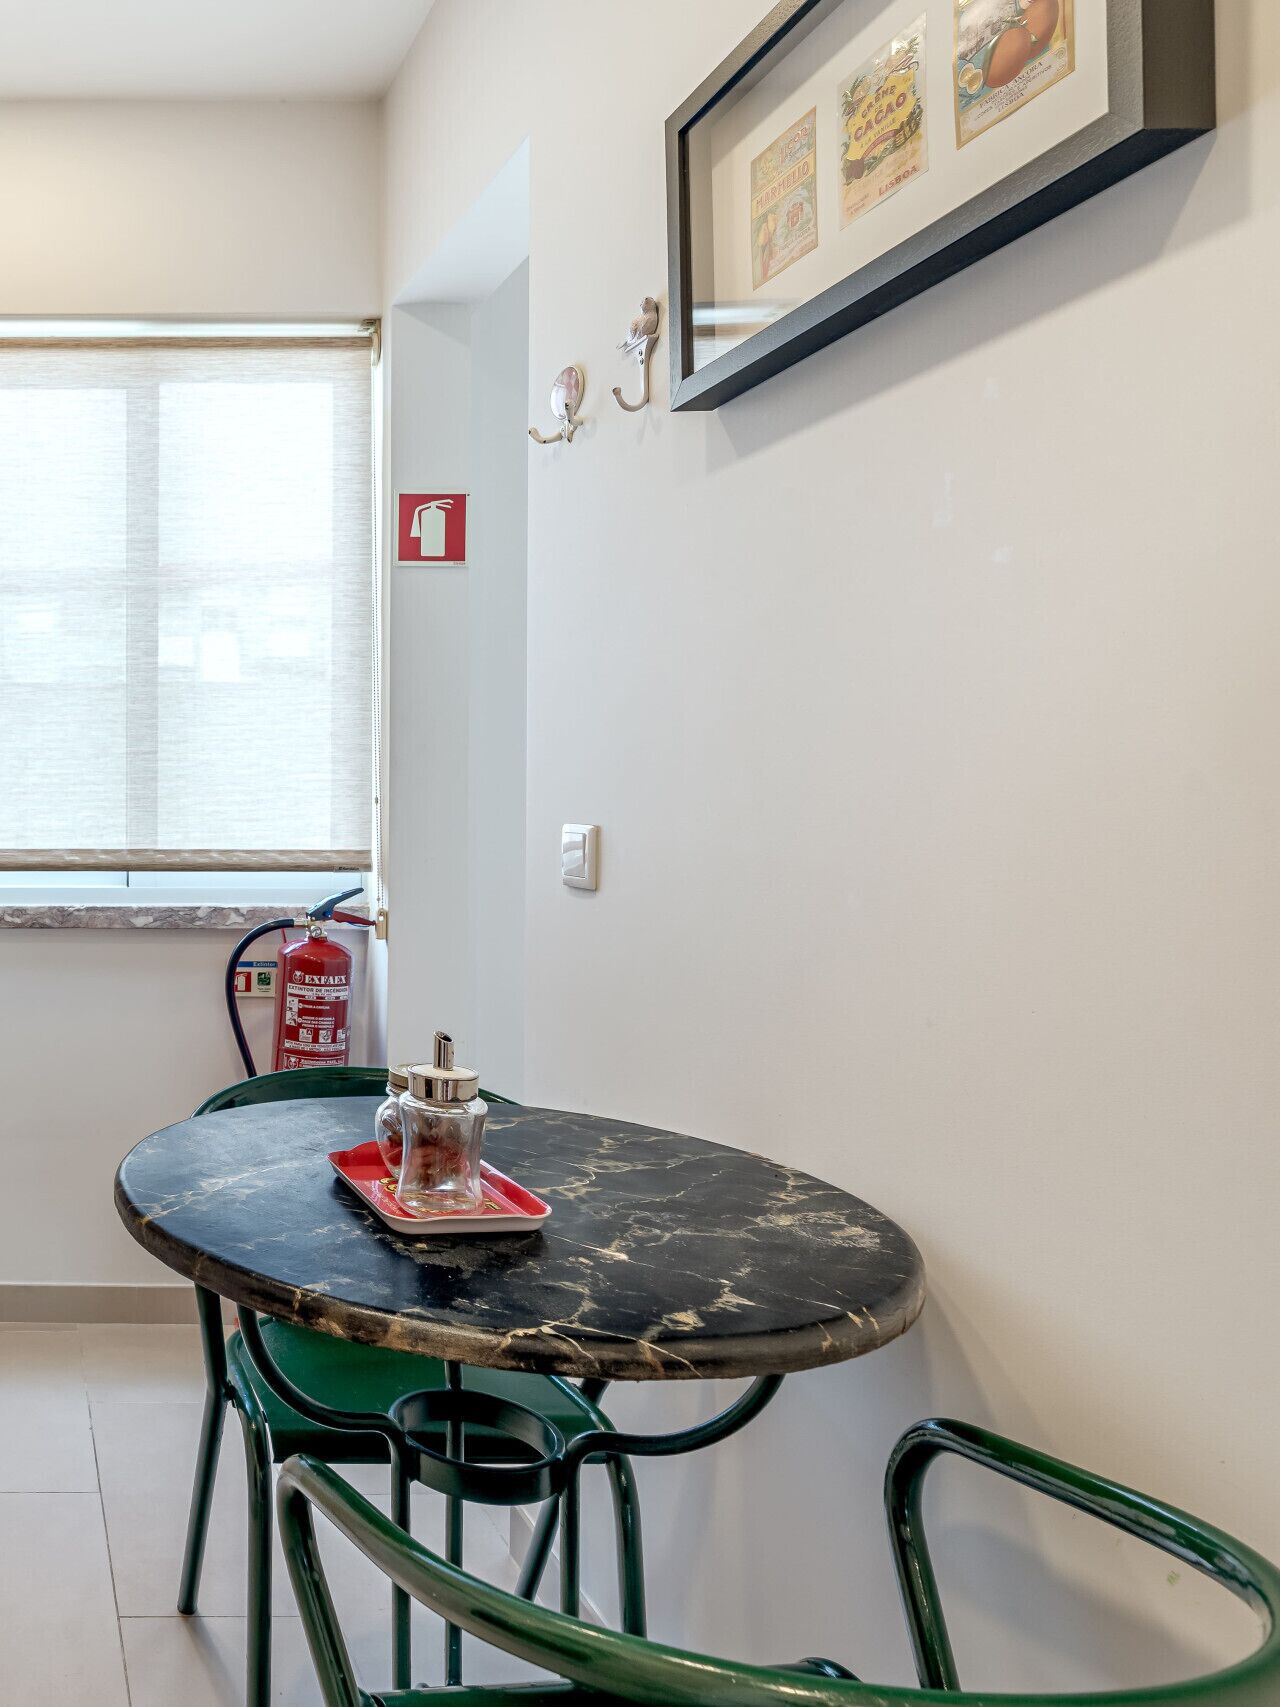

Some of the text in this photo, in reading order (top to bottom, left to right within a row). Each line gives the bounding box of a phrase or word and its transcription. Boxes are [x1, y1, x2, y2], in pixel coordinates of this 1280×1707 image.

[853, 92, 907, 142] CACAO
[878, 164, 920, 197] LISBOA
[288, 984, 314, 992] EXTINTOR
[305, 975, 347, 984] EXFAEX
